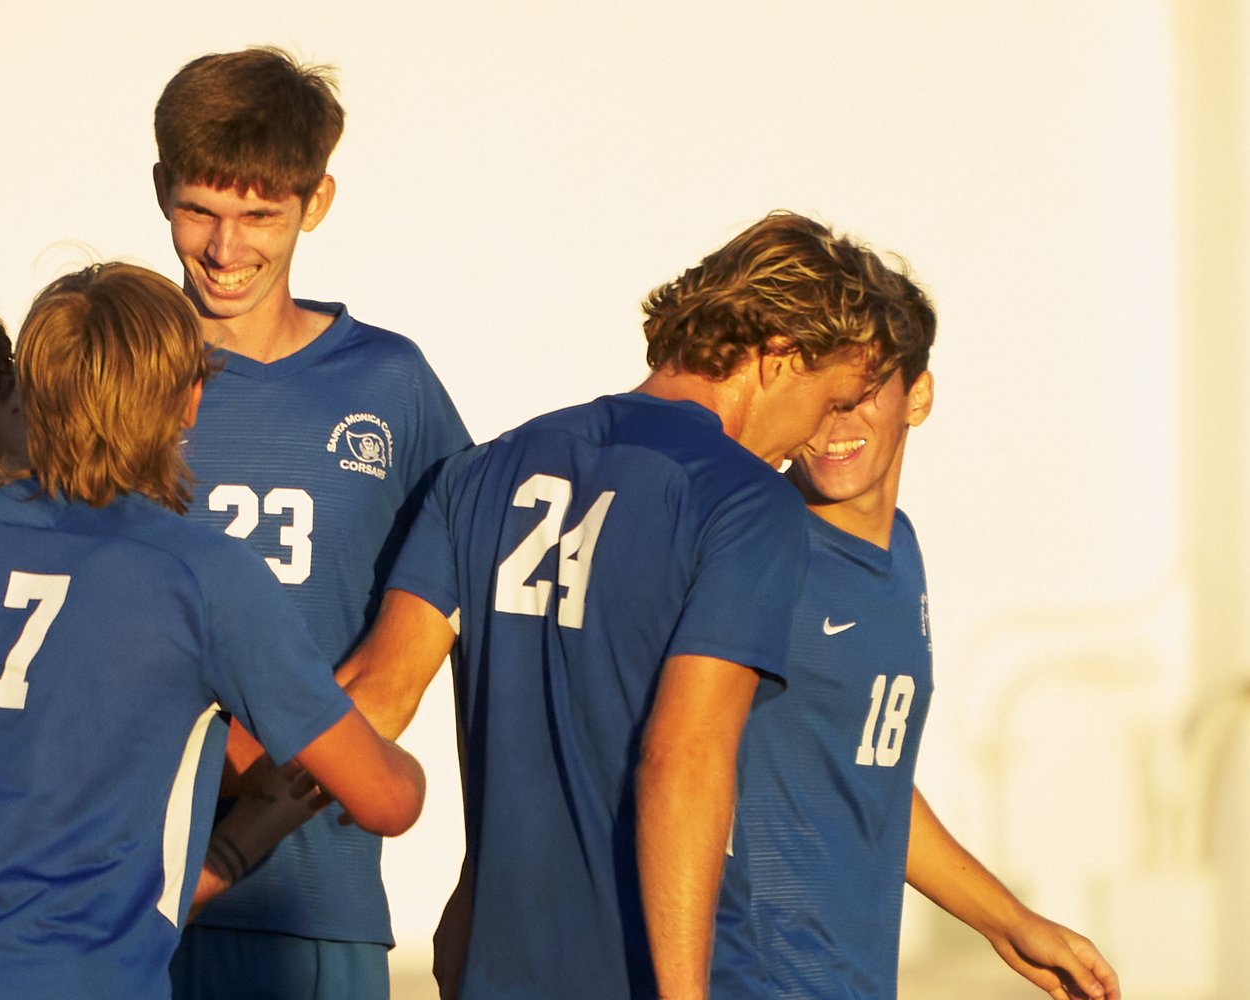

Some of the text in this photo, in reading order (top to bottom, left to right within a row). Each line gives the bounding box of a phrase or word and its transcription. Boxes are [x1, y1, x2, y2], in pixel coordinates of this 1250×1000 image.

[327, 422, 347, 453] SANTA
[344, 413, 381, 427] MONICA
[208, 485, 314, 585] 23
[495, 474, 616, 629] 24
[855, 674, 916, 768] 18
